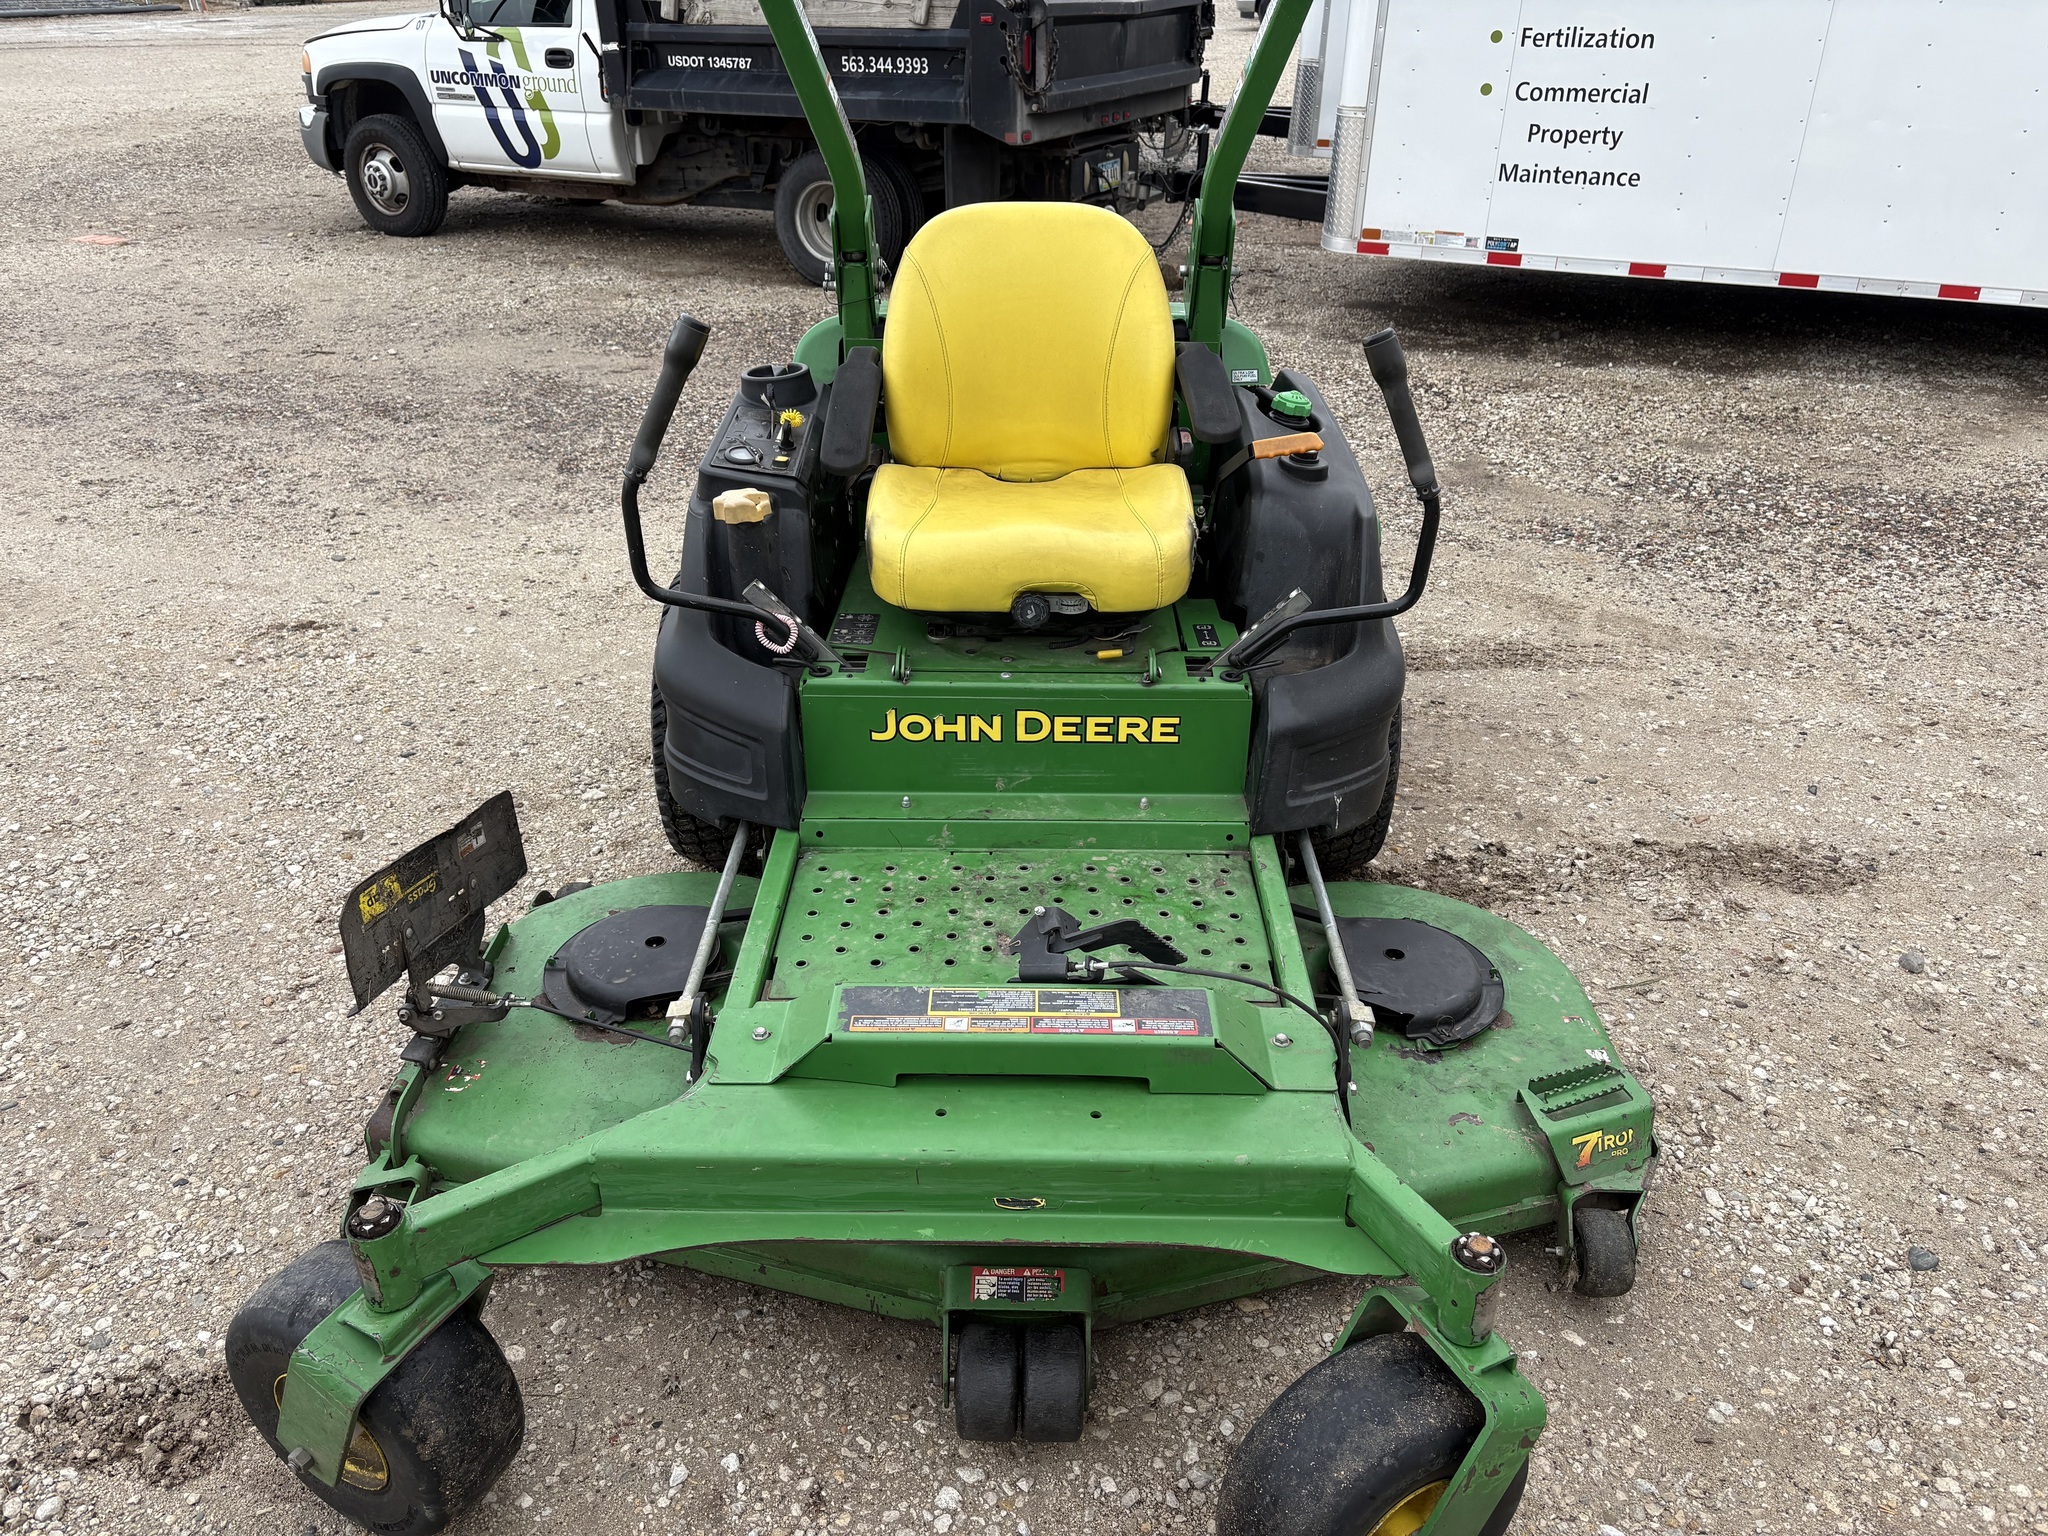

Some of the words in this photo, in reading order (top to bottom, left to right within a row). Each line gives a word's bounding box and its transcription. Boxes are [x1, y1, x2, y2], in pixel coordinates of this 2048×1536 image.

[415, 19, 425, 30] 07
[1520, 26, 1655, 49] Fertilization
[667, 55, 704, 68] USDOT
[707, 56, 752, 69] 1345787
[841, 55, 929, 74] 563.344.9393
[430, 69, 521, 89] UNCOMMON
[523, 69, 578, 100] ground
[1515, 81, 1650, 104] Commercial
[1527, 123, 1624, 151] Property
[1498, 163, 1641, 187] Maintenance
[870, 707, 1003, 744] JOHN
[1015, 709, 1182, 744] DEERE
[408, 878, 436, 904] Grass
[1611, 1147, 1629, 1157] PRO
